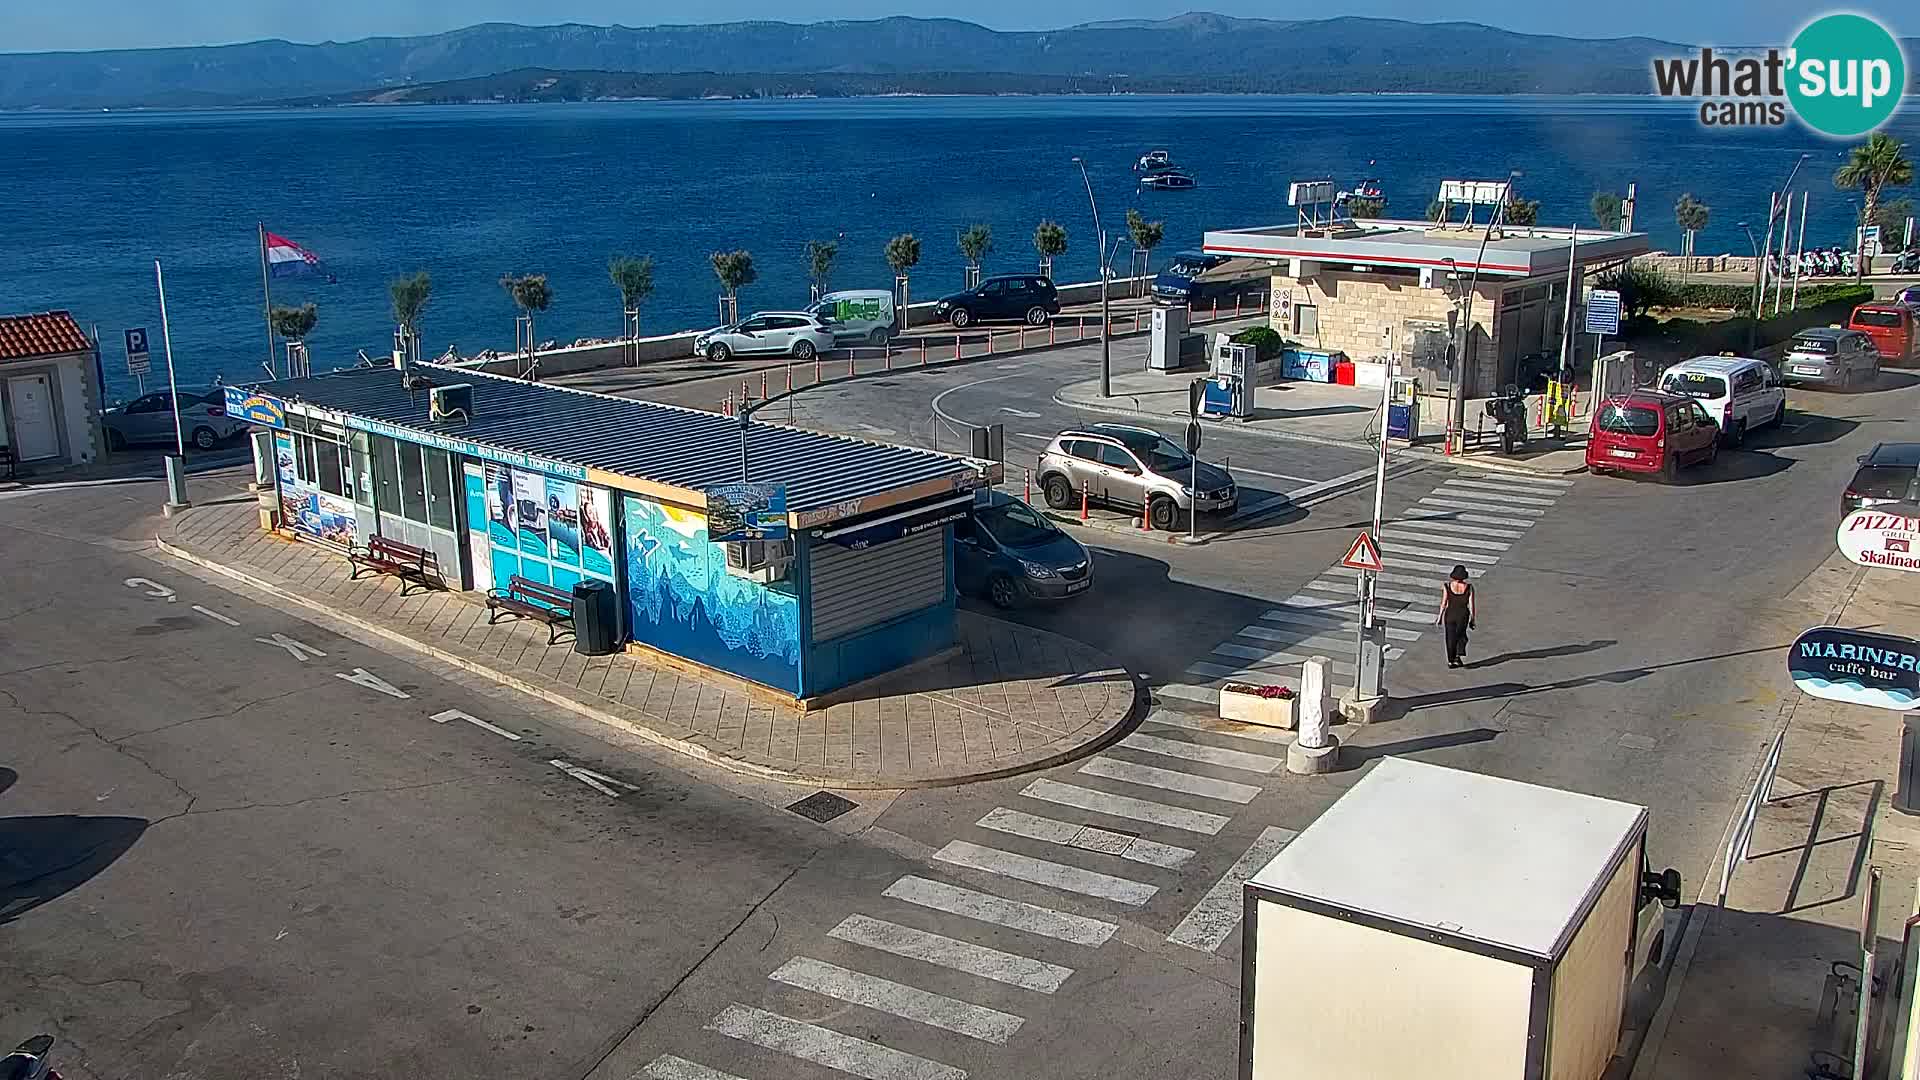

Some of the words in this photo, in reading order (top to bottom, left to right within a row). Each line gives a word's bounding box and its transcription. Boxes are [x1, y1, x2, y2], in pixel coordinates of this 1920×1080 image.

[130, 332, 142, 350] P
[1687, 374, 1705, 382] TAXI
[396, 427, 436, 444] AUTOBUSNA
[436, 437, 467, 451] POSTAJA
[477, 447, 493, 459] BUS
[494, 450, 526, 465] STATION
[527, 457, 554, 472] TICKET
[554, 463, 584, 478] OFFICE
[1848, 515, 1920, 533] PIZZE
[1881, 530, 1917, 540] GRILL
[1829, 662, 1866, 676] caffe
[1870, 665, 1898, 680] bar
